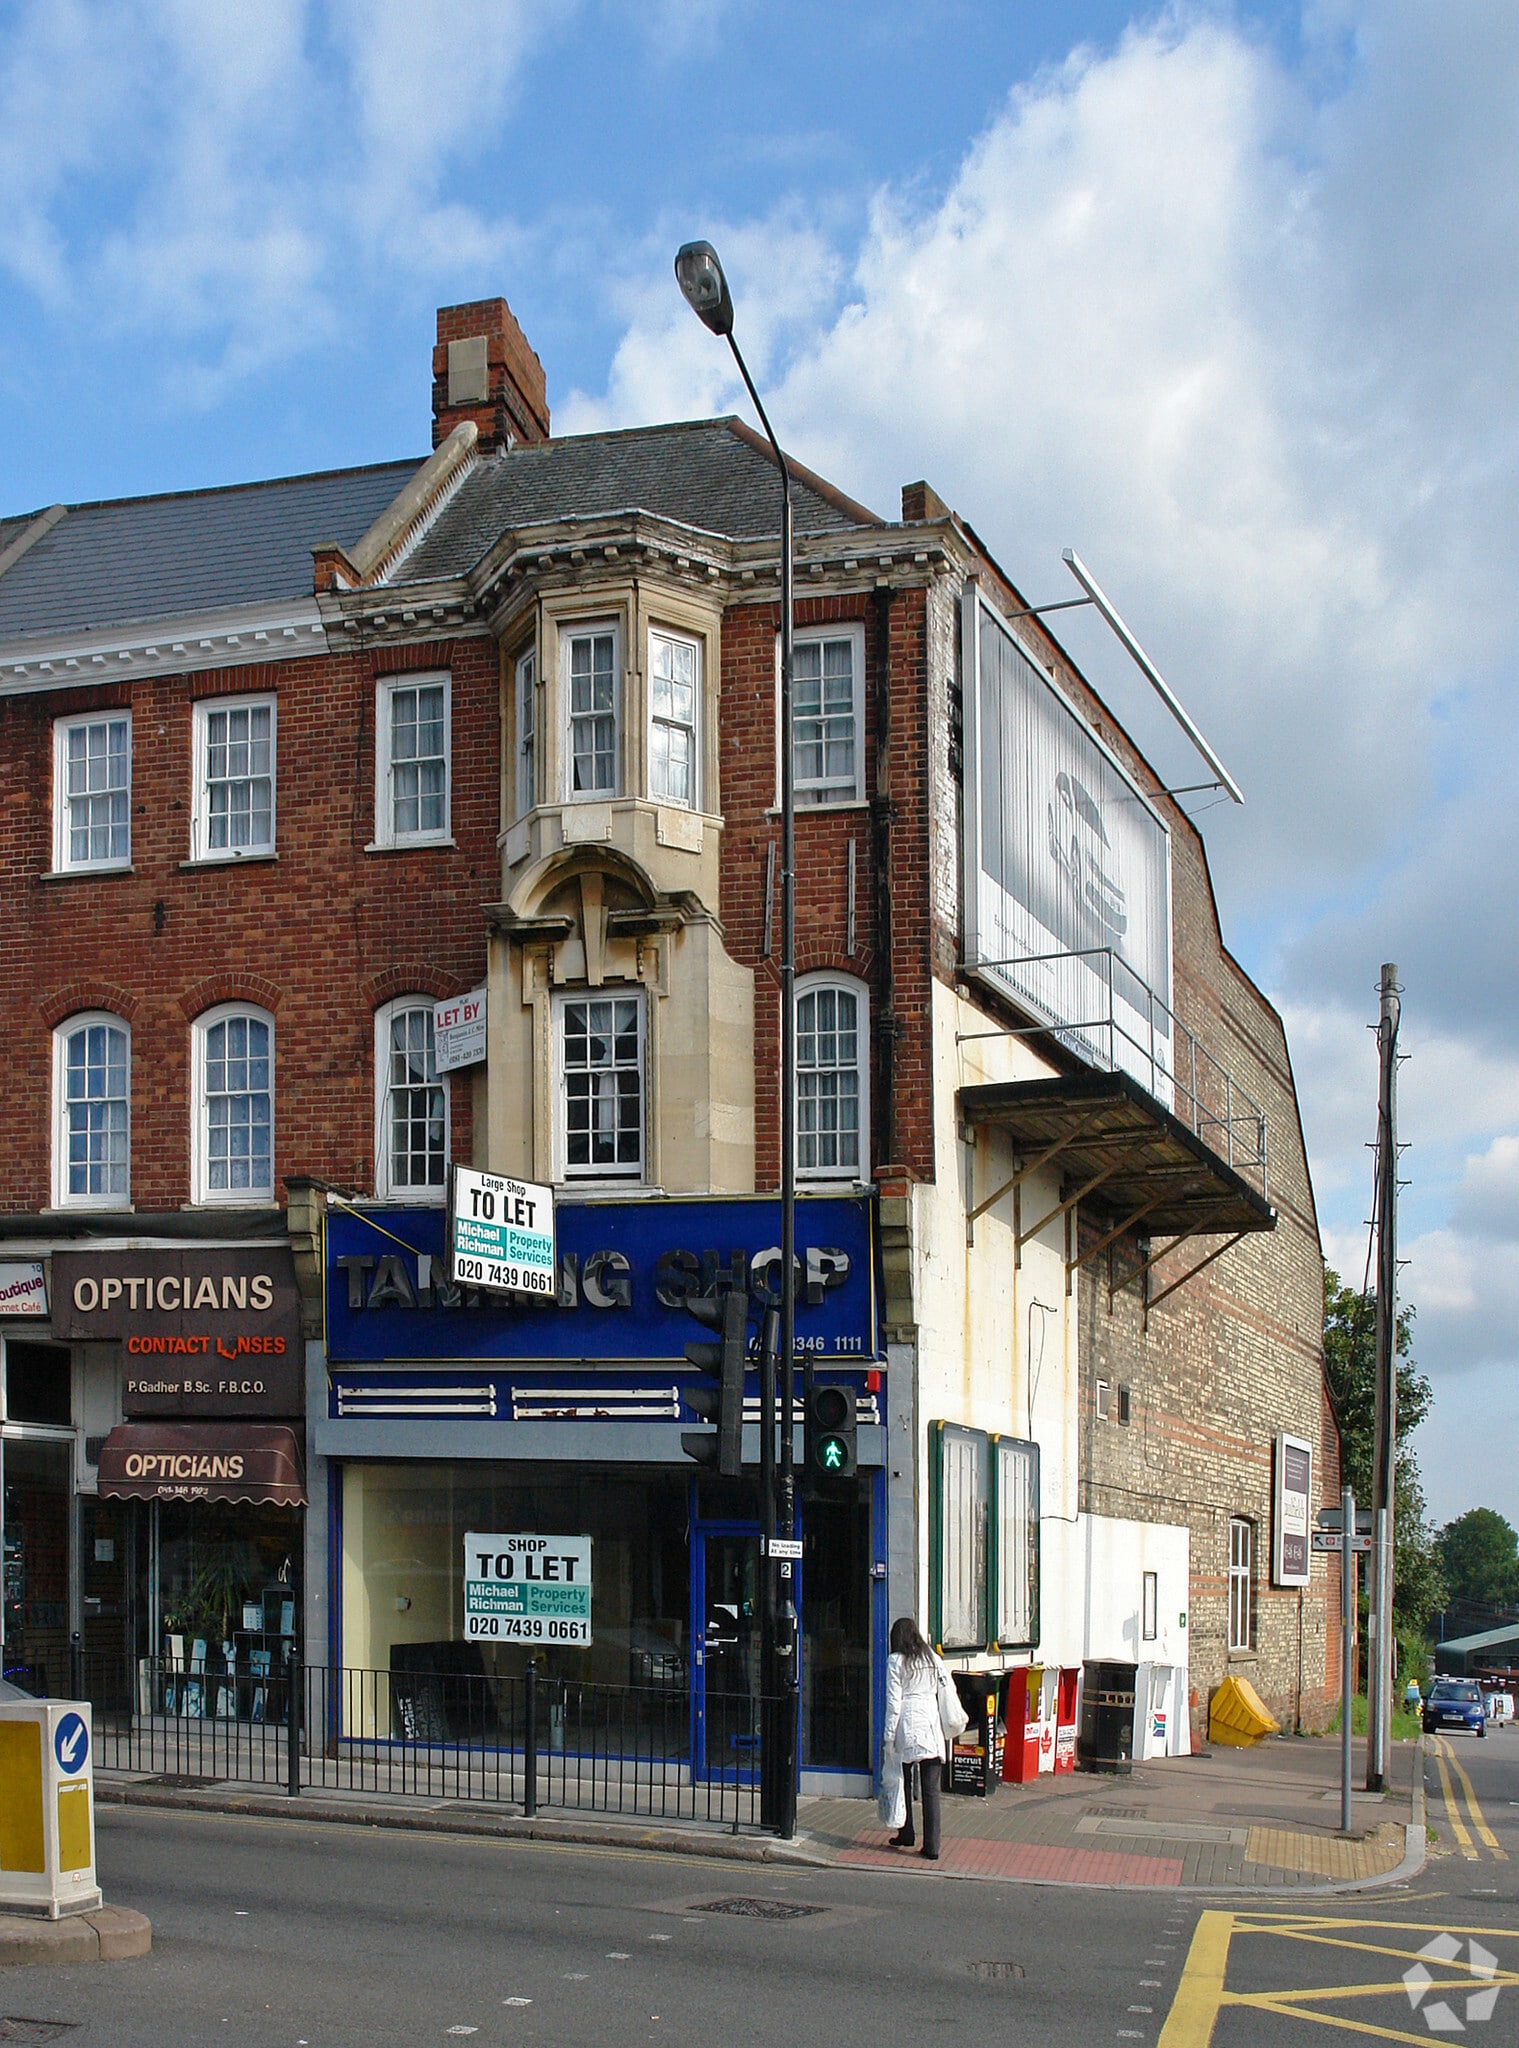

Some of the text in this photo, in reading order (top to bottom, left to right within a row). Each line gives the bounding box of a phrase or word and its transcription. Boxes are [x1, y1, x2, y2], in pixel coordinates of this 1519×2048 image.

[437, 1001, 480, 1028] LET BY
[481, 1175, 526, 1197] Large Shop
[470, 1188, 536, 1228] TO LET
[457, 1221, 500, 1242] Michael
[457, 1235, 504, 1256] Richman
[509, 1231, 552, 1253] Property
[509, 1247, 552, 1265] Services
[32, 1264, 42, 1272] 10
[458, 1259, 552, 1292] 020 7439 0661
[656, 1246, 849, 1308] SHOP
[73, 1275, 273, 1311] OPTICIANS
[21, 1302, 41, 1312] Café
[128, 1336, 210, 1354] CONTACT
[834, 1336, 861, 1351] 1111
[184, 1380, 213, 1393] B.Sc.
[219, 1381, 266, 1394] F.B.C.O.
[125, 1454, 244, 1479] OPTICIANS
[508, 1539, 547, 1552] SHOP
[476, 1553, 579, 1582] TO LET
[782, 1564, 790, 1576] 2
[469, 1584, 518, 1597] Michael
[531, 1587, 585, 1602] Property
[469, 1598, 524, 1611] Richman
[531, 1601, 586, 1614] Services
[469, 1617, 587, 1639] 020 7439 0661
[954, 1756, 982, 1765] recruit
